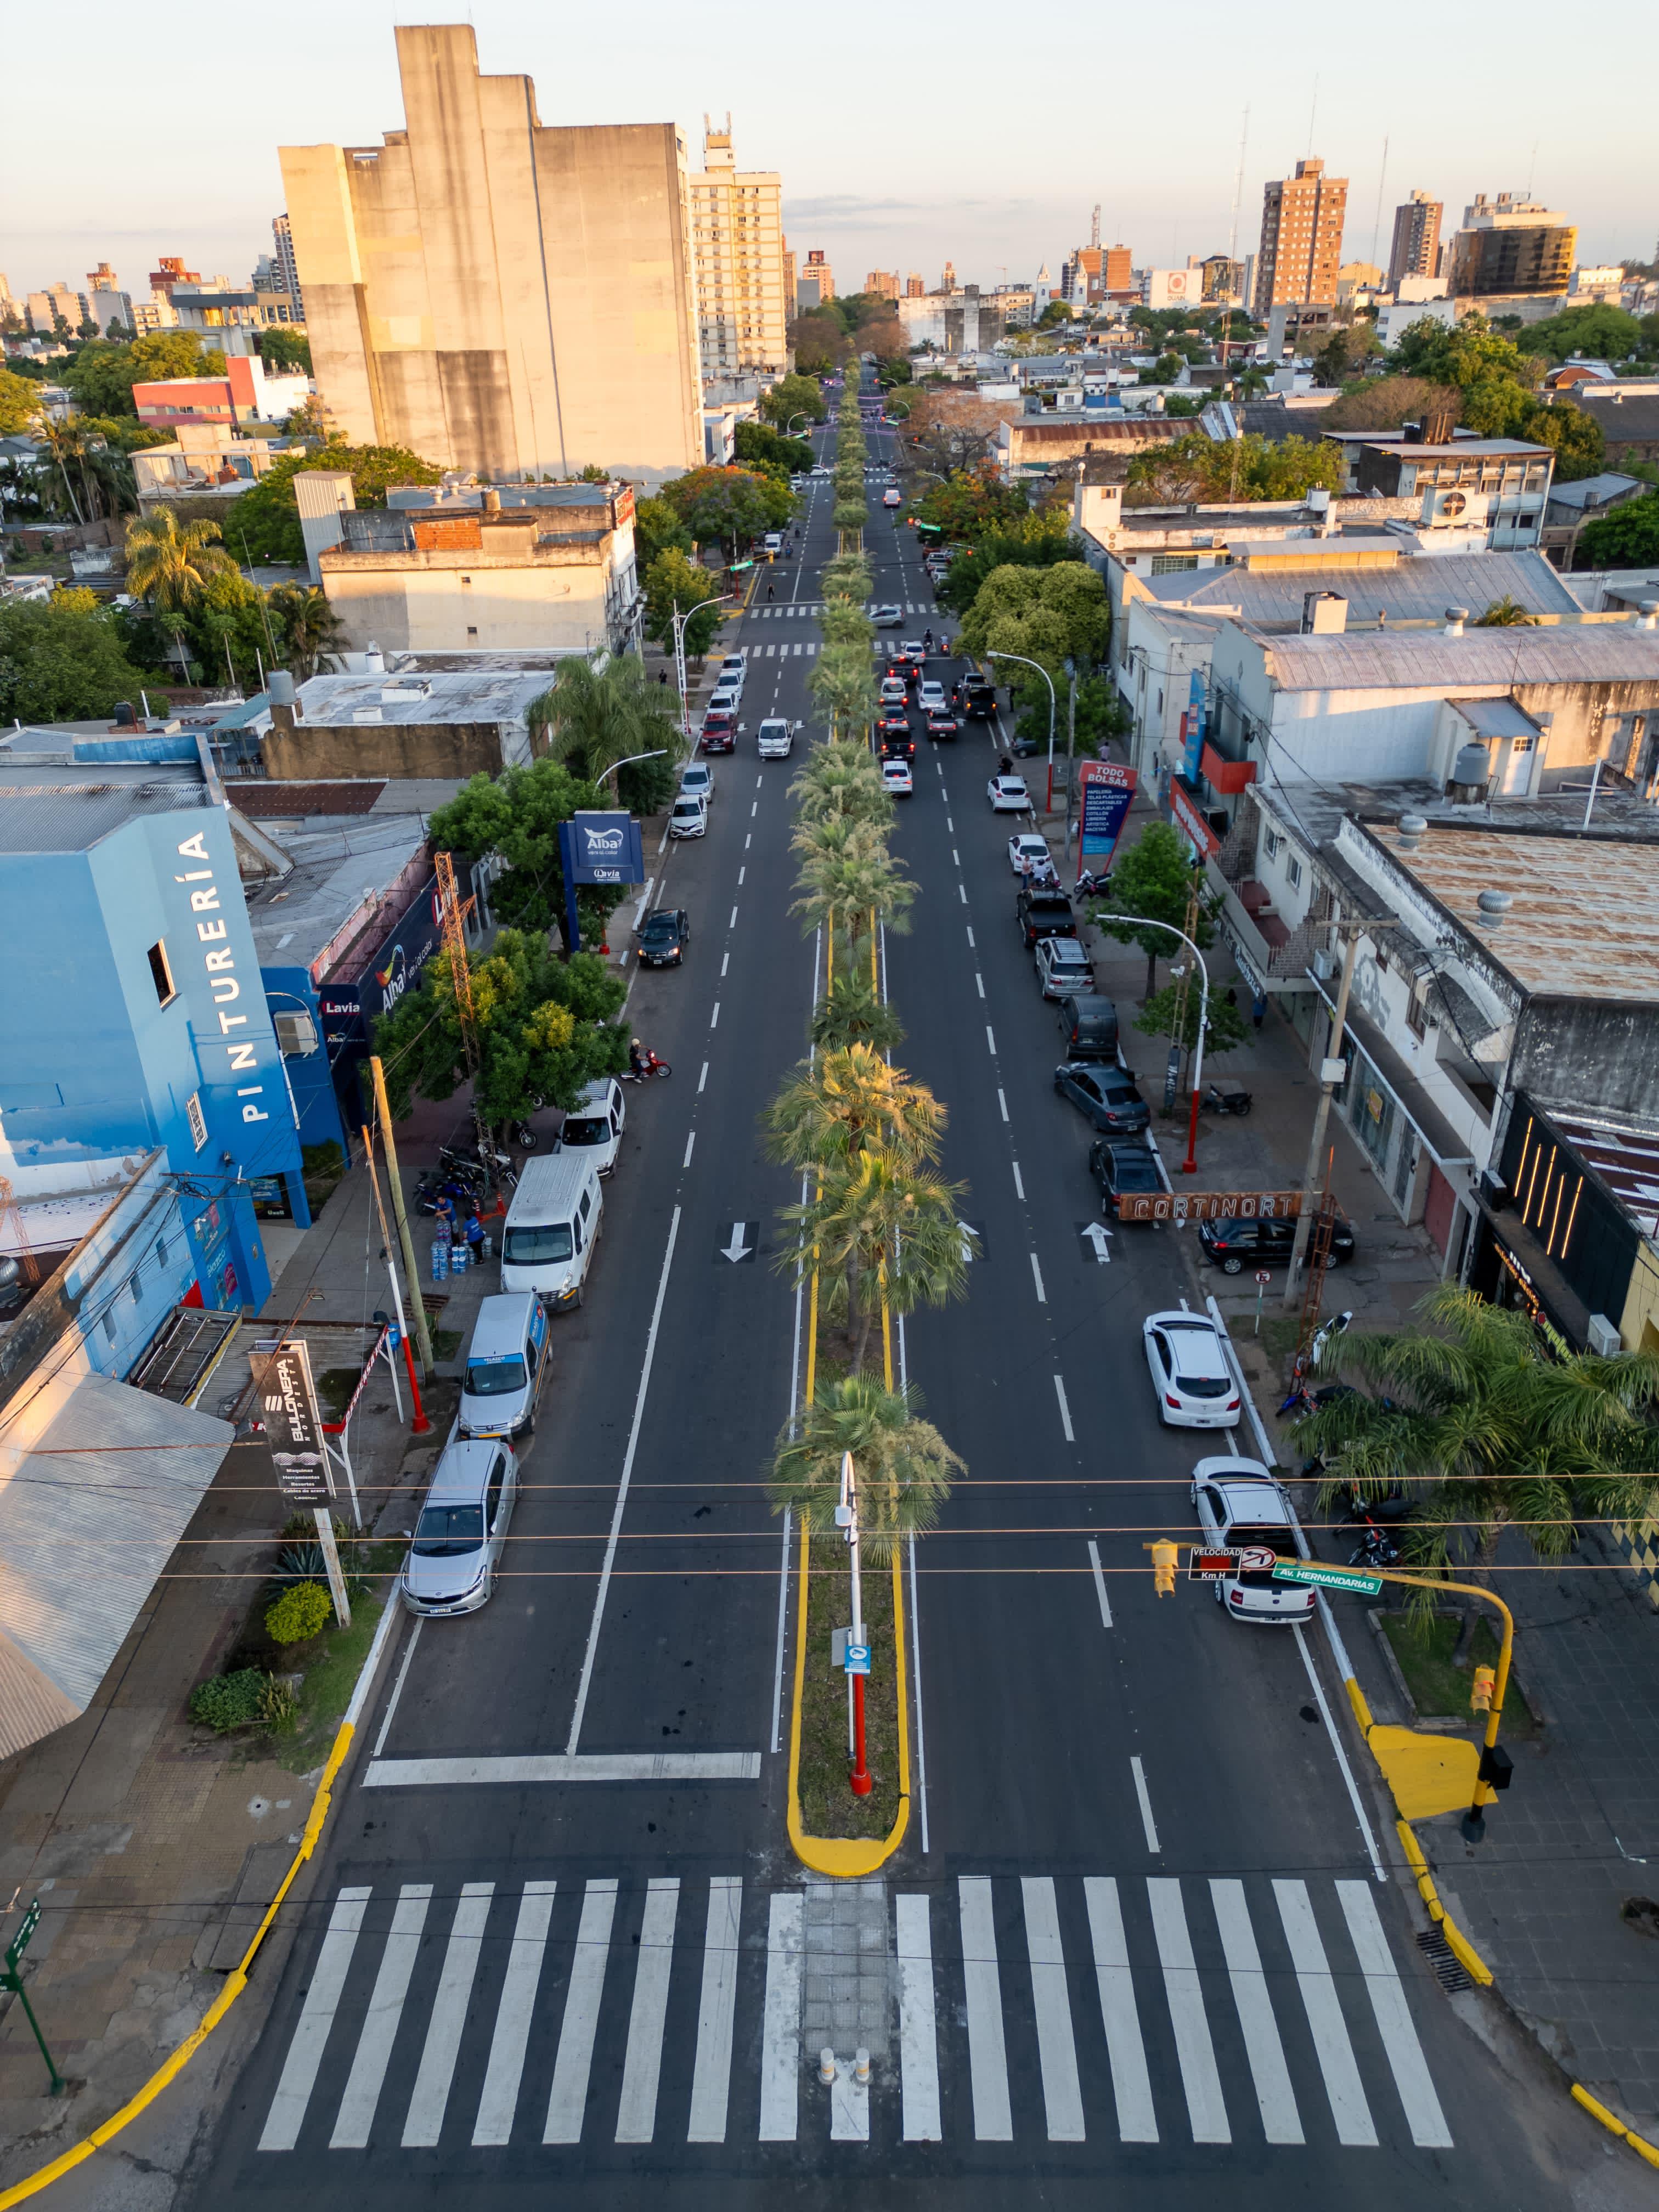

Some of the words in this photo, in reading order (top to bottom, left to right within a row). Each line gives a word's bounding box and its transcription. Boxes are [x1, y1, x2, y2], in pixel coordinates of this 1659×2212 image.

[1088, 774, 1128, 787] BOLSAS
[1097, 766, 1124, 777] TODO
[588, 838, 618, 849] Alba
[421, 938, 433, 960] color
[174, 831, 269, 1123] PINTURERÍA
[326, 1002, 360, 1013] Lavia
[1135, 1197, 1292, 1218] CORTINORT
[276, 1359, 304, 1442] BULONERA
[287, 1358, 311, 1442] NORDESTE
[1280, 1568, 1294, 1577] Av.
[1296, 1570, 1375, 1590] HERNANDARIAS
